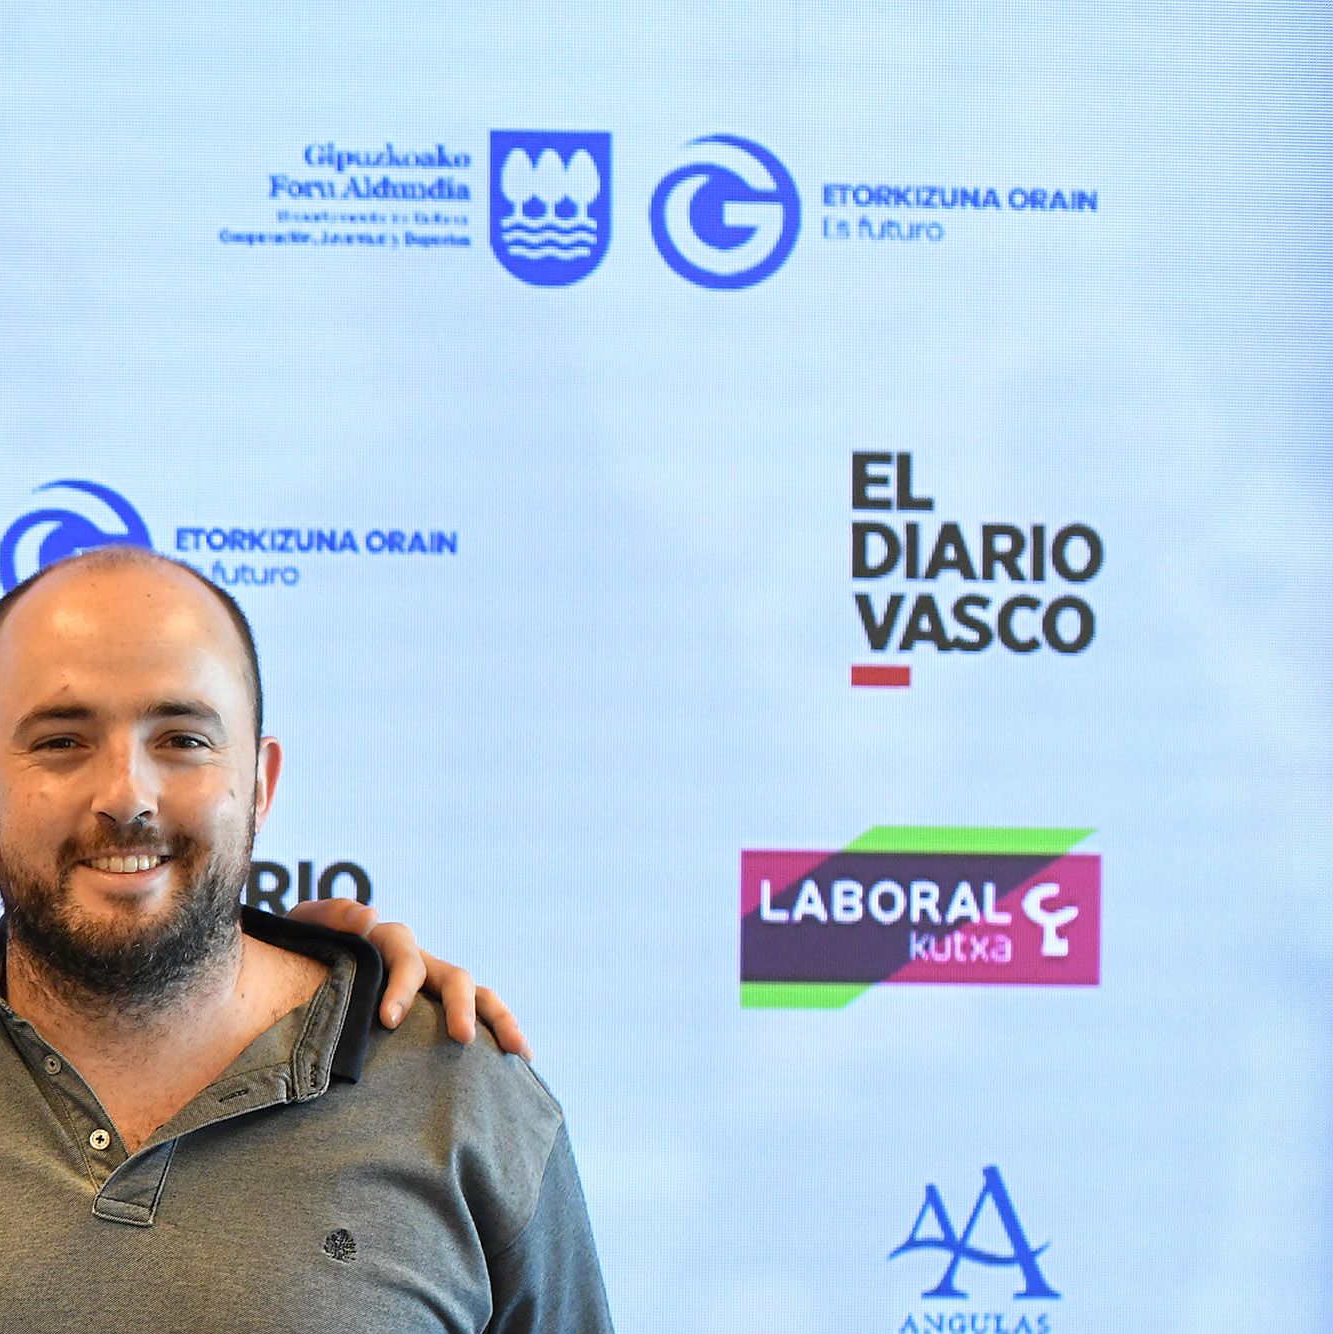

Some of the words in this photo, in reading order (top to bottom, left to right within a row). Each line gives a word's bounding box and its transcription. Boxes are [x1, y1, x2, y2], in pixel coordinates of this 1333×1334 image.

[270, 175, 336, 198] Foru
[342, 176, 471, 201] Aldundia
[823, 184, 1001, 209] ETORKIZUNA
[1008, 188, 1098, 212] ORAIN
[858, 215, 945, 241] futuro
[852, 451, 935, 512] EL
[176, 528, 359, 553] ETORKIZUNA
[365, 530, 457, 554] ORAIN
[852, 521, 1105, 584] DIARIO
[210, 560, 300, 587] futuro
[854, 593, 1096, 655] VASCO
[246, 860, 372, 914] RIO
[761, 880, 1011, 924] LABORAL
[910, 932, 1012, 962] kutxa
